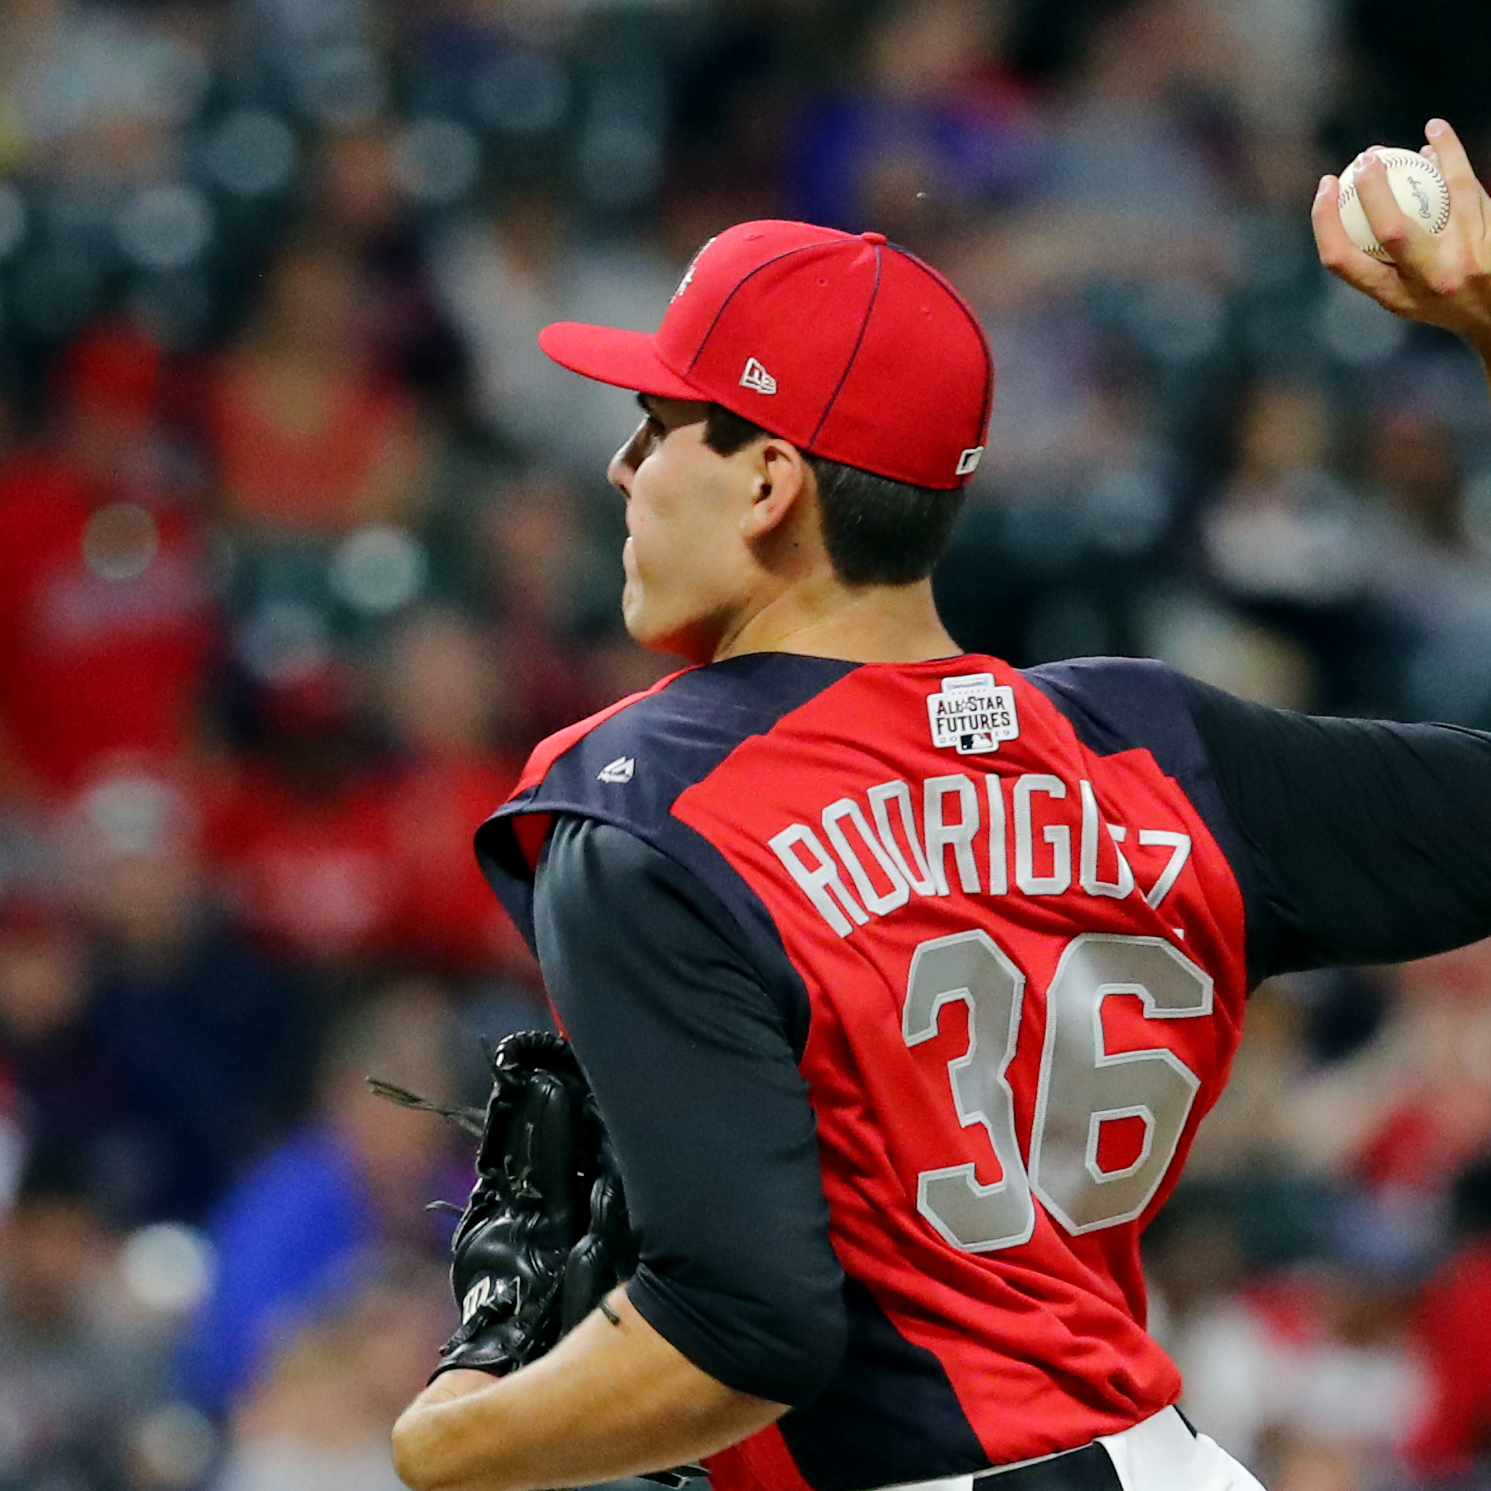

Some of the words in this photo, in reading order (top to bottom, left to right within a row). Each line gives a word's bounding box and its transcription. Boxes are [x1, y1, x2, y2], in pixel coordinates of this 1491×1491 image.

[936, 711, 1011, 735] FUTURES
[768, 773, 1192, 939] RODRIGUZ
[901, 928, 1215, 1254] 36
